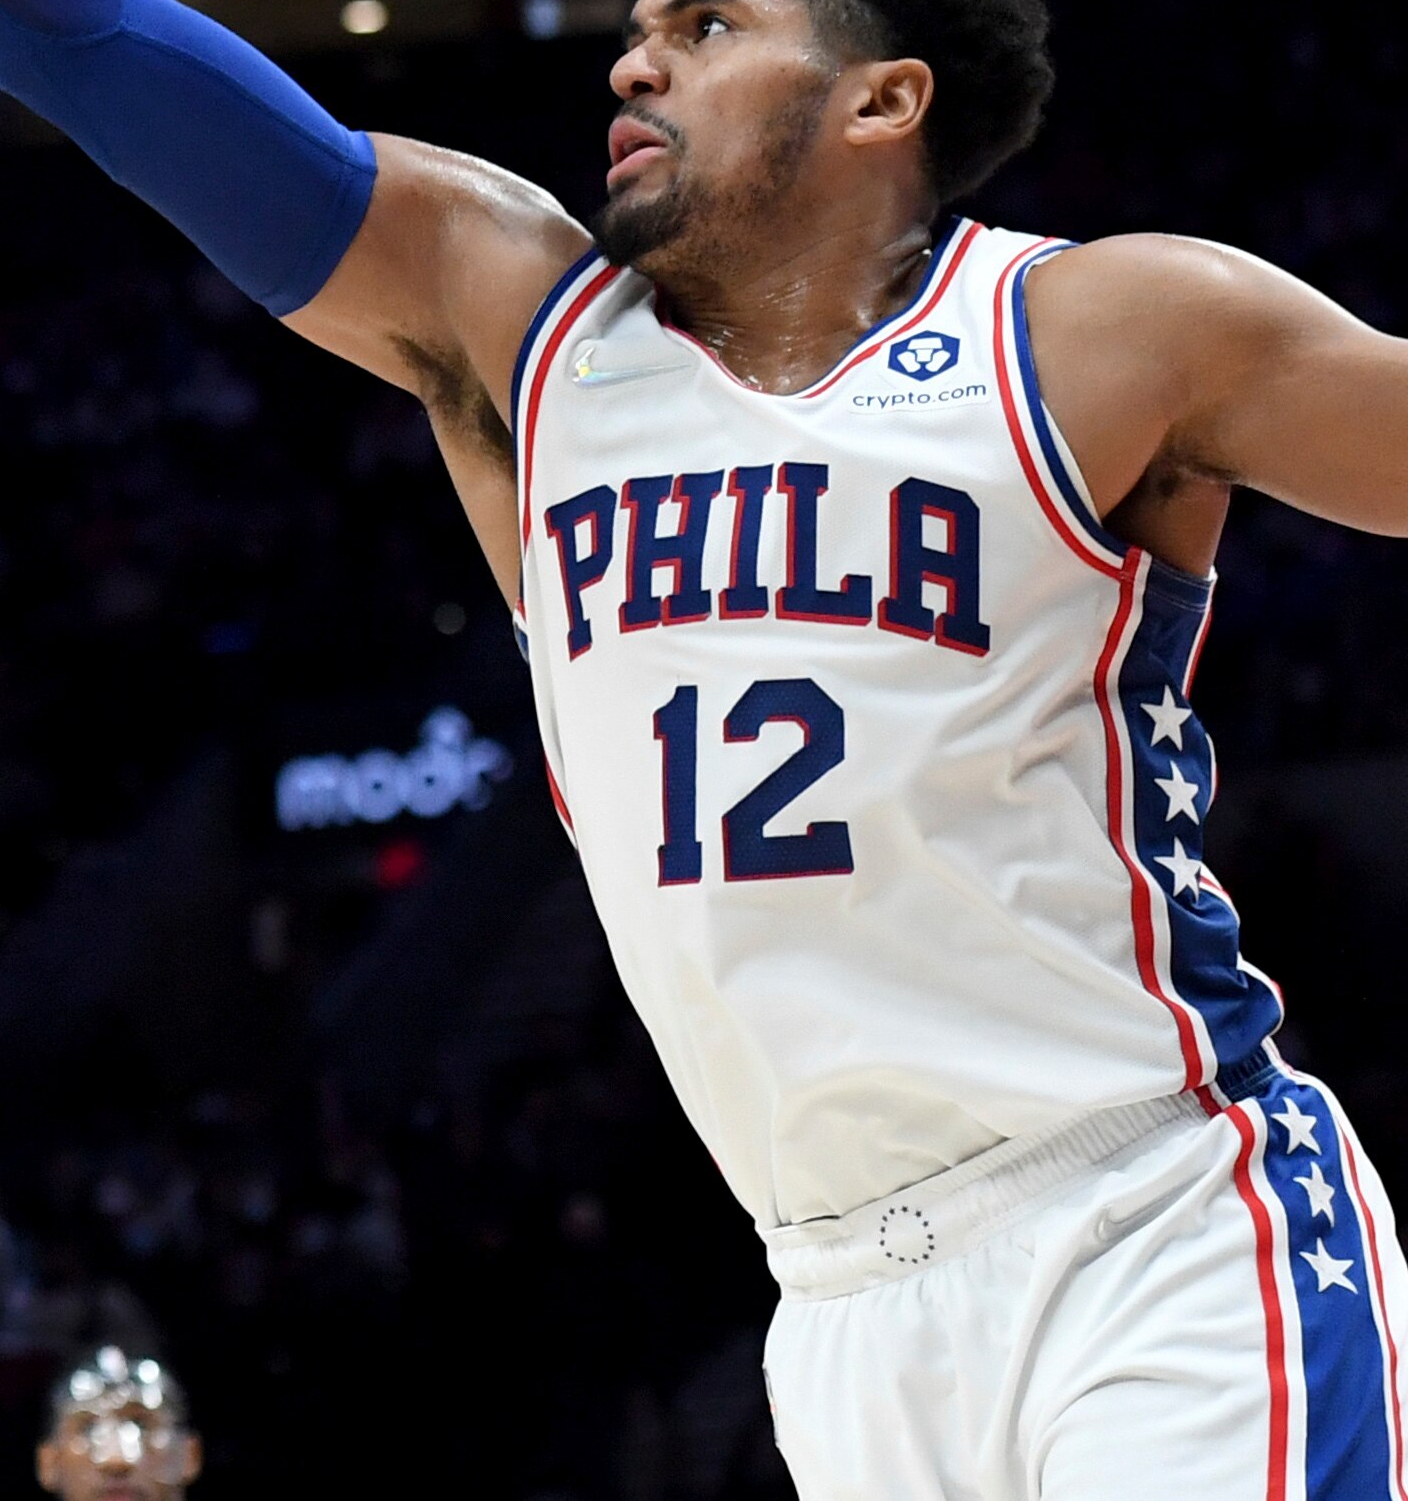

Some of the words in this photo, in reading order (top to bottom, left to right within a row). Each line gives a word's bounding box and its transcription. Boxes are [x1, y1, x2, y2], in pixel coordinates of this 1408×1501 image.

[852, 384, 987, 409] crypto.com
[544, 461, 991, 662] PHILA
[653, 677, 855, 888] 12
